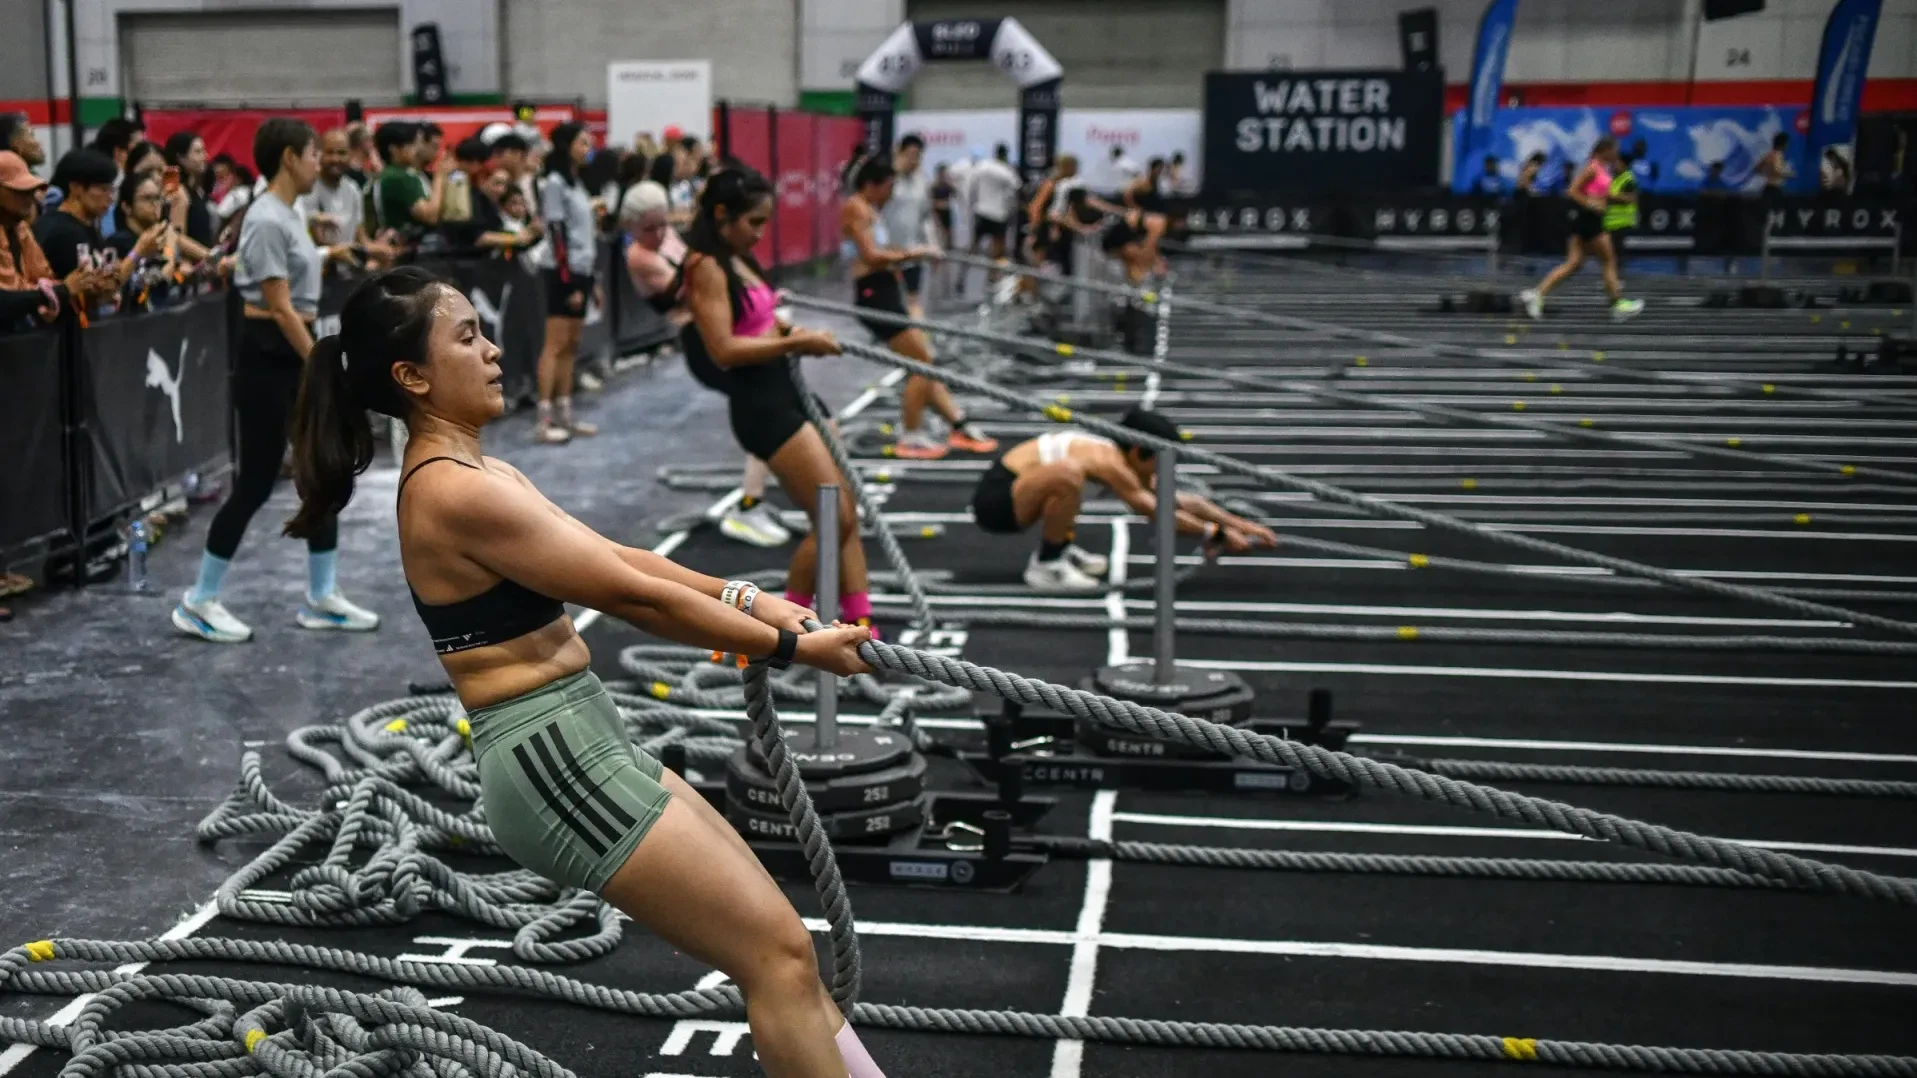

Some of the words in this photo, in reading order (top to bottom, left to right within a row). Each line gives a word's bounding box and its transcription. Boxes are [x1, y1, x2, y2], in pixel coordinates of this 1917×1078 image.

[1726, 47, 1751, 67] 24
[1254, 79, 1391, 114] WATER
[1236, 117, 1406, 152] STATION
[1767, 209, 1898, 229] HYROX
[1107, 738, 1165, 755] CENTR
[748, 789, 781, 805] CEN
[750, 818, 799, 836] CENT
